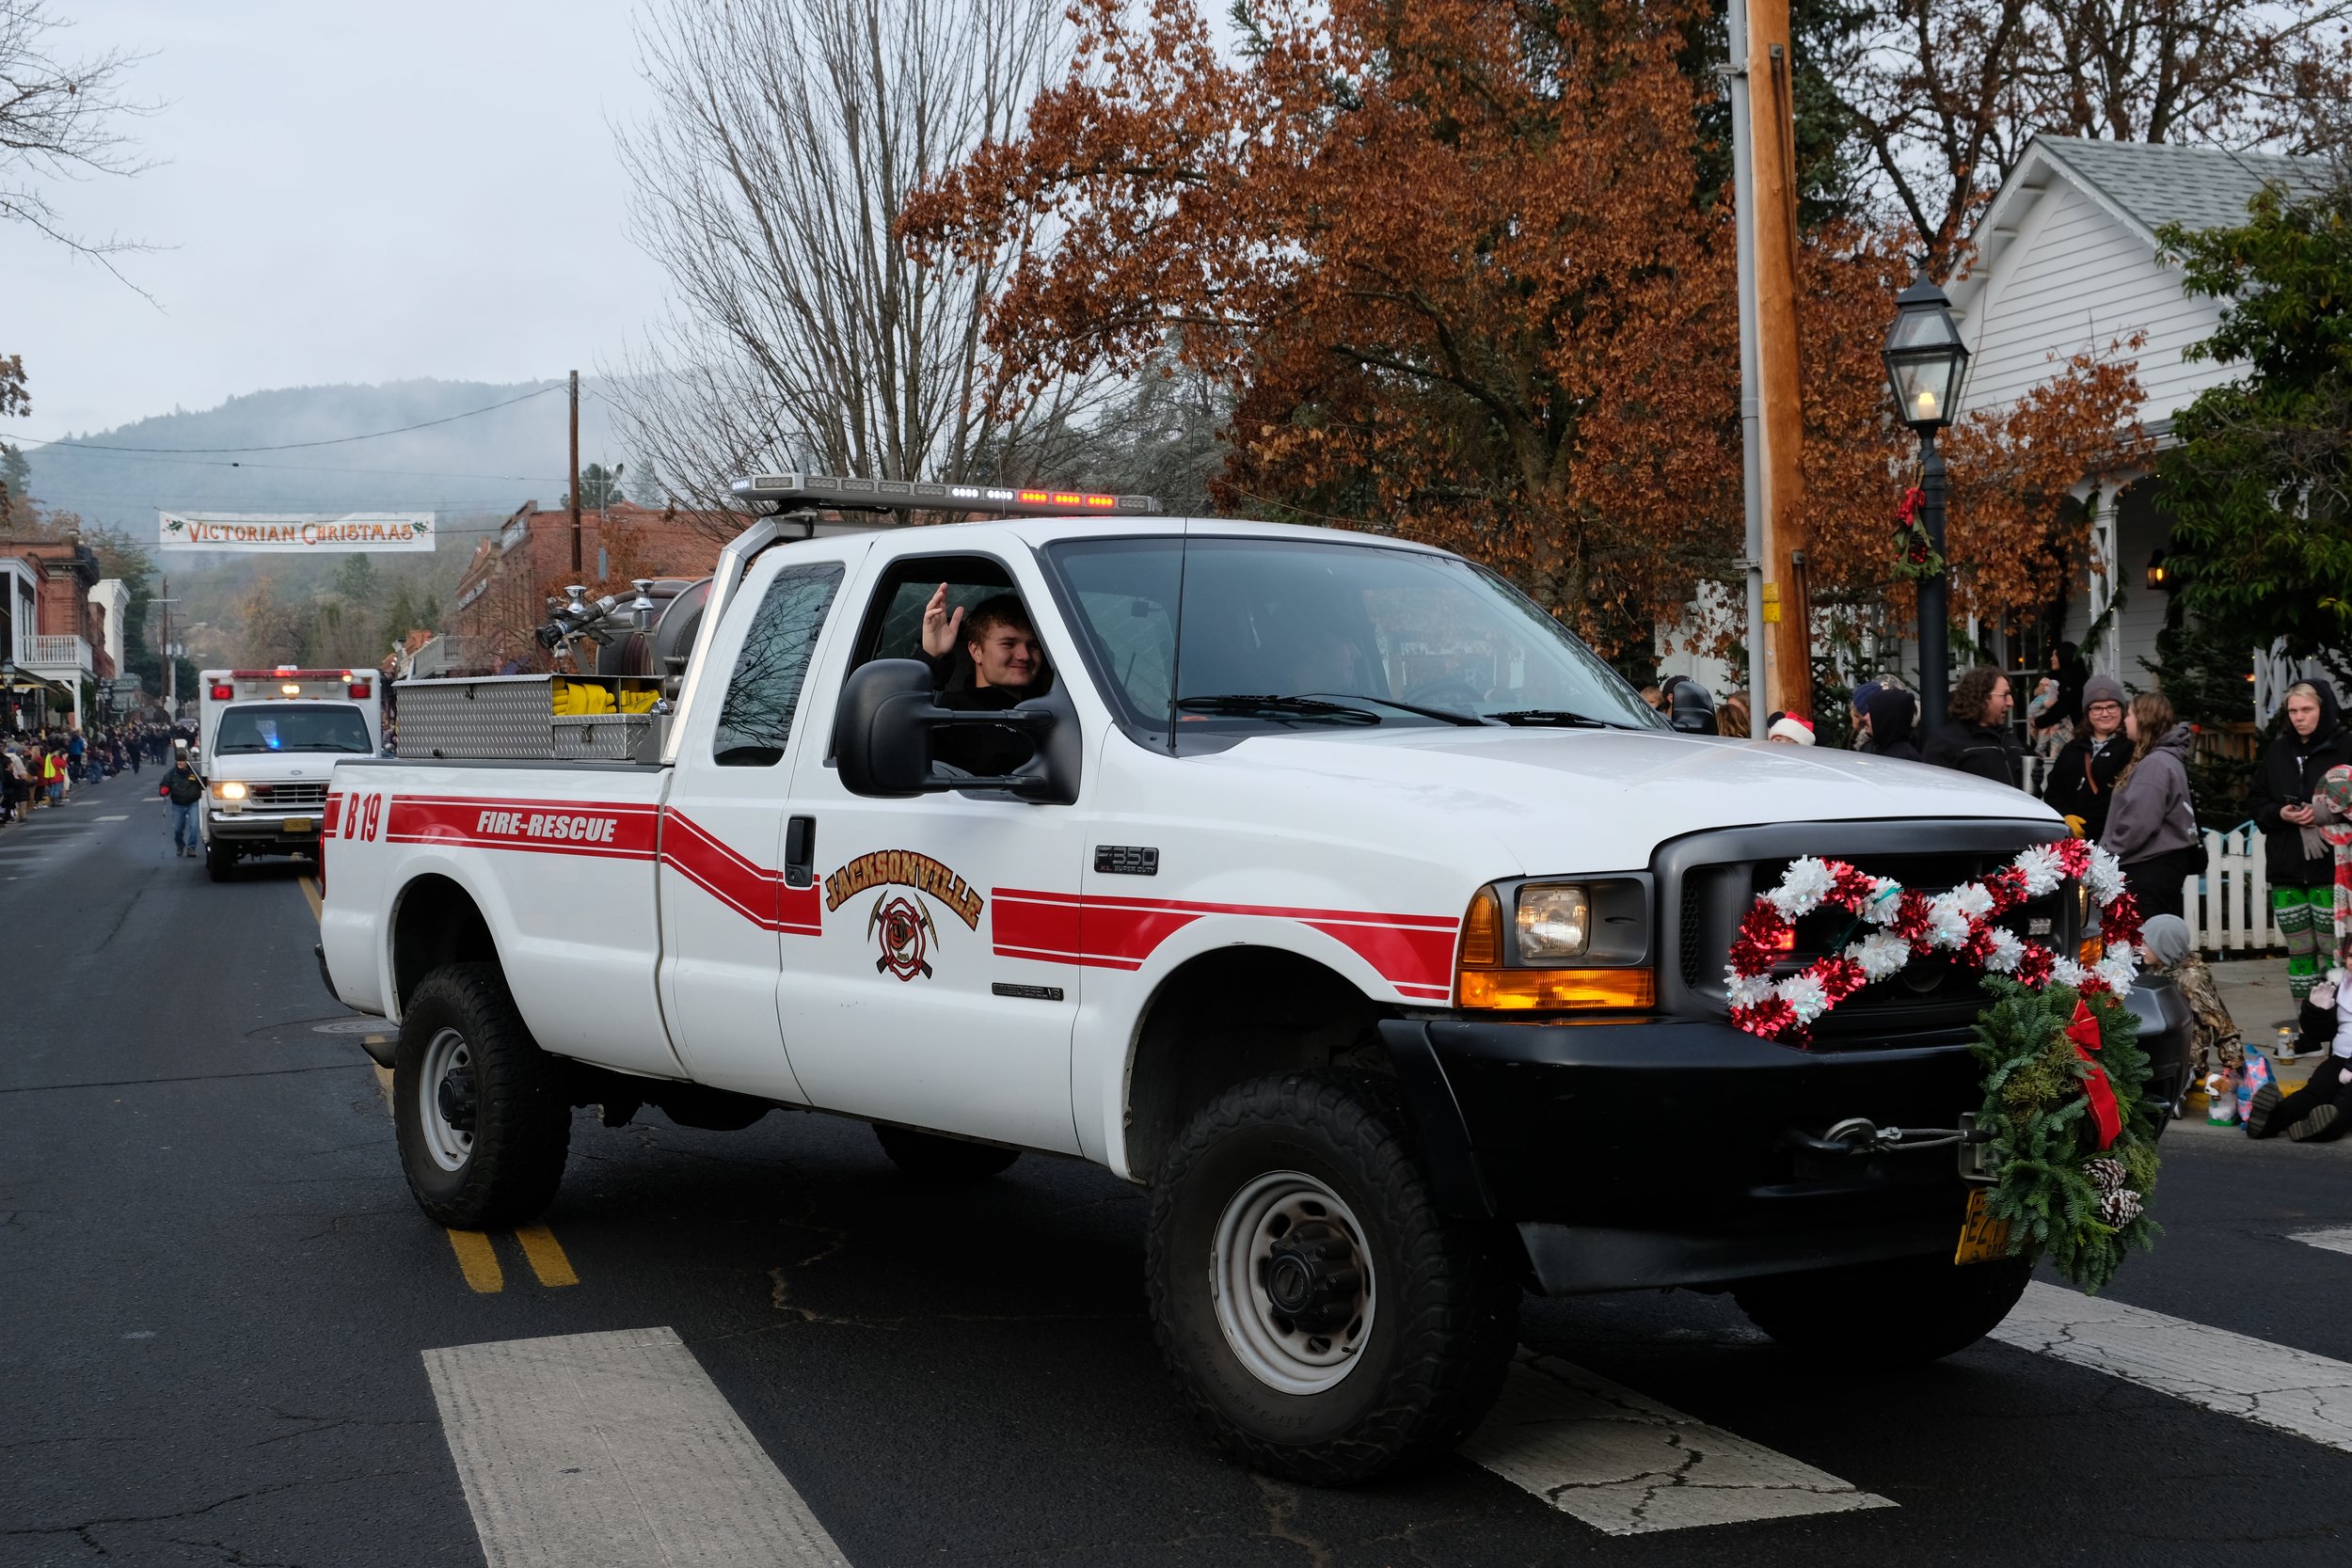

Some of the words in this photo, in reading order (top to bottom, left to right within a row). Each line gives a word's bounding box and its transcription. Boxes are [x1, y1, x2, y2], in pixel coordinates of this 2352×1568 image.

[185, 521, 294, 543] VICTORIAN
[299, 522, 414, 545] CHRISTMAS
[476, 811, 617, 843] FIRE-RESCUE
[824, 849, 984, 931] JACKSONVILLE
